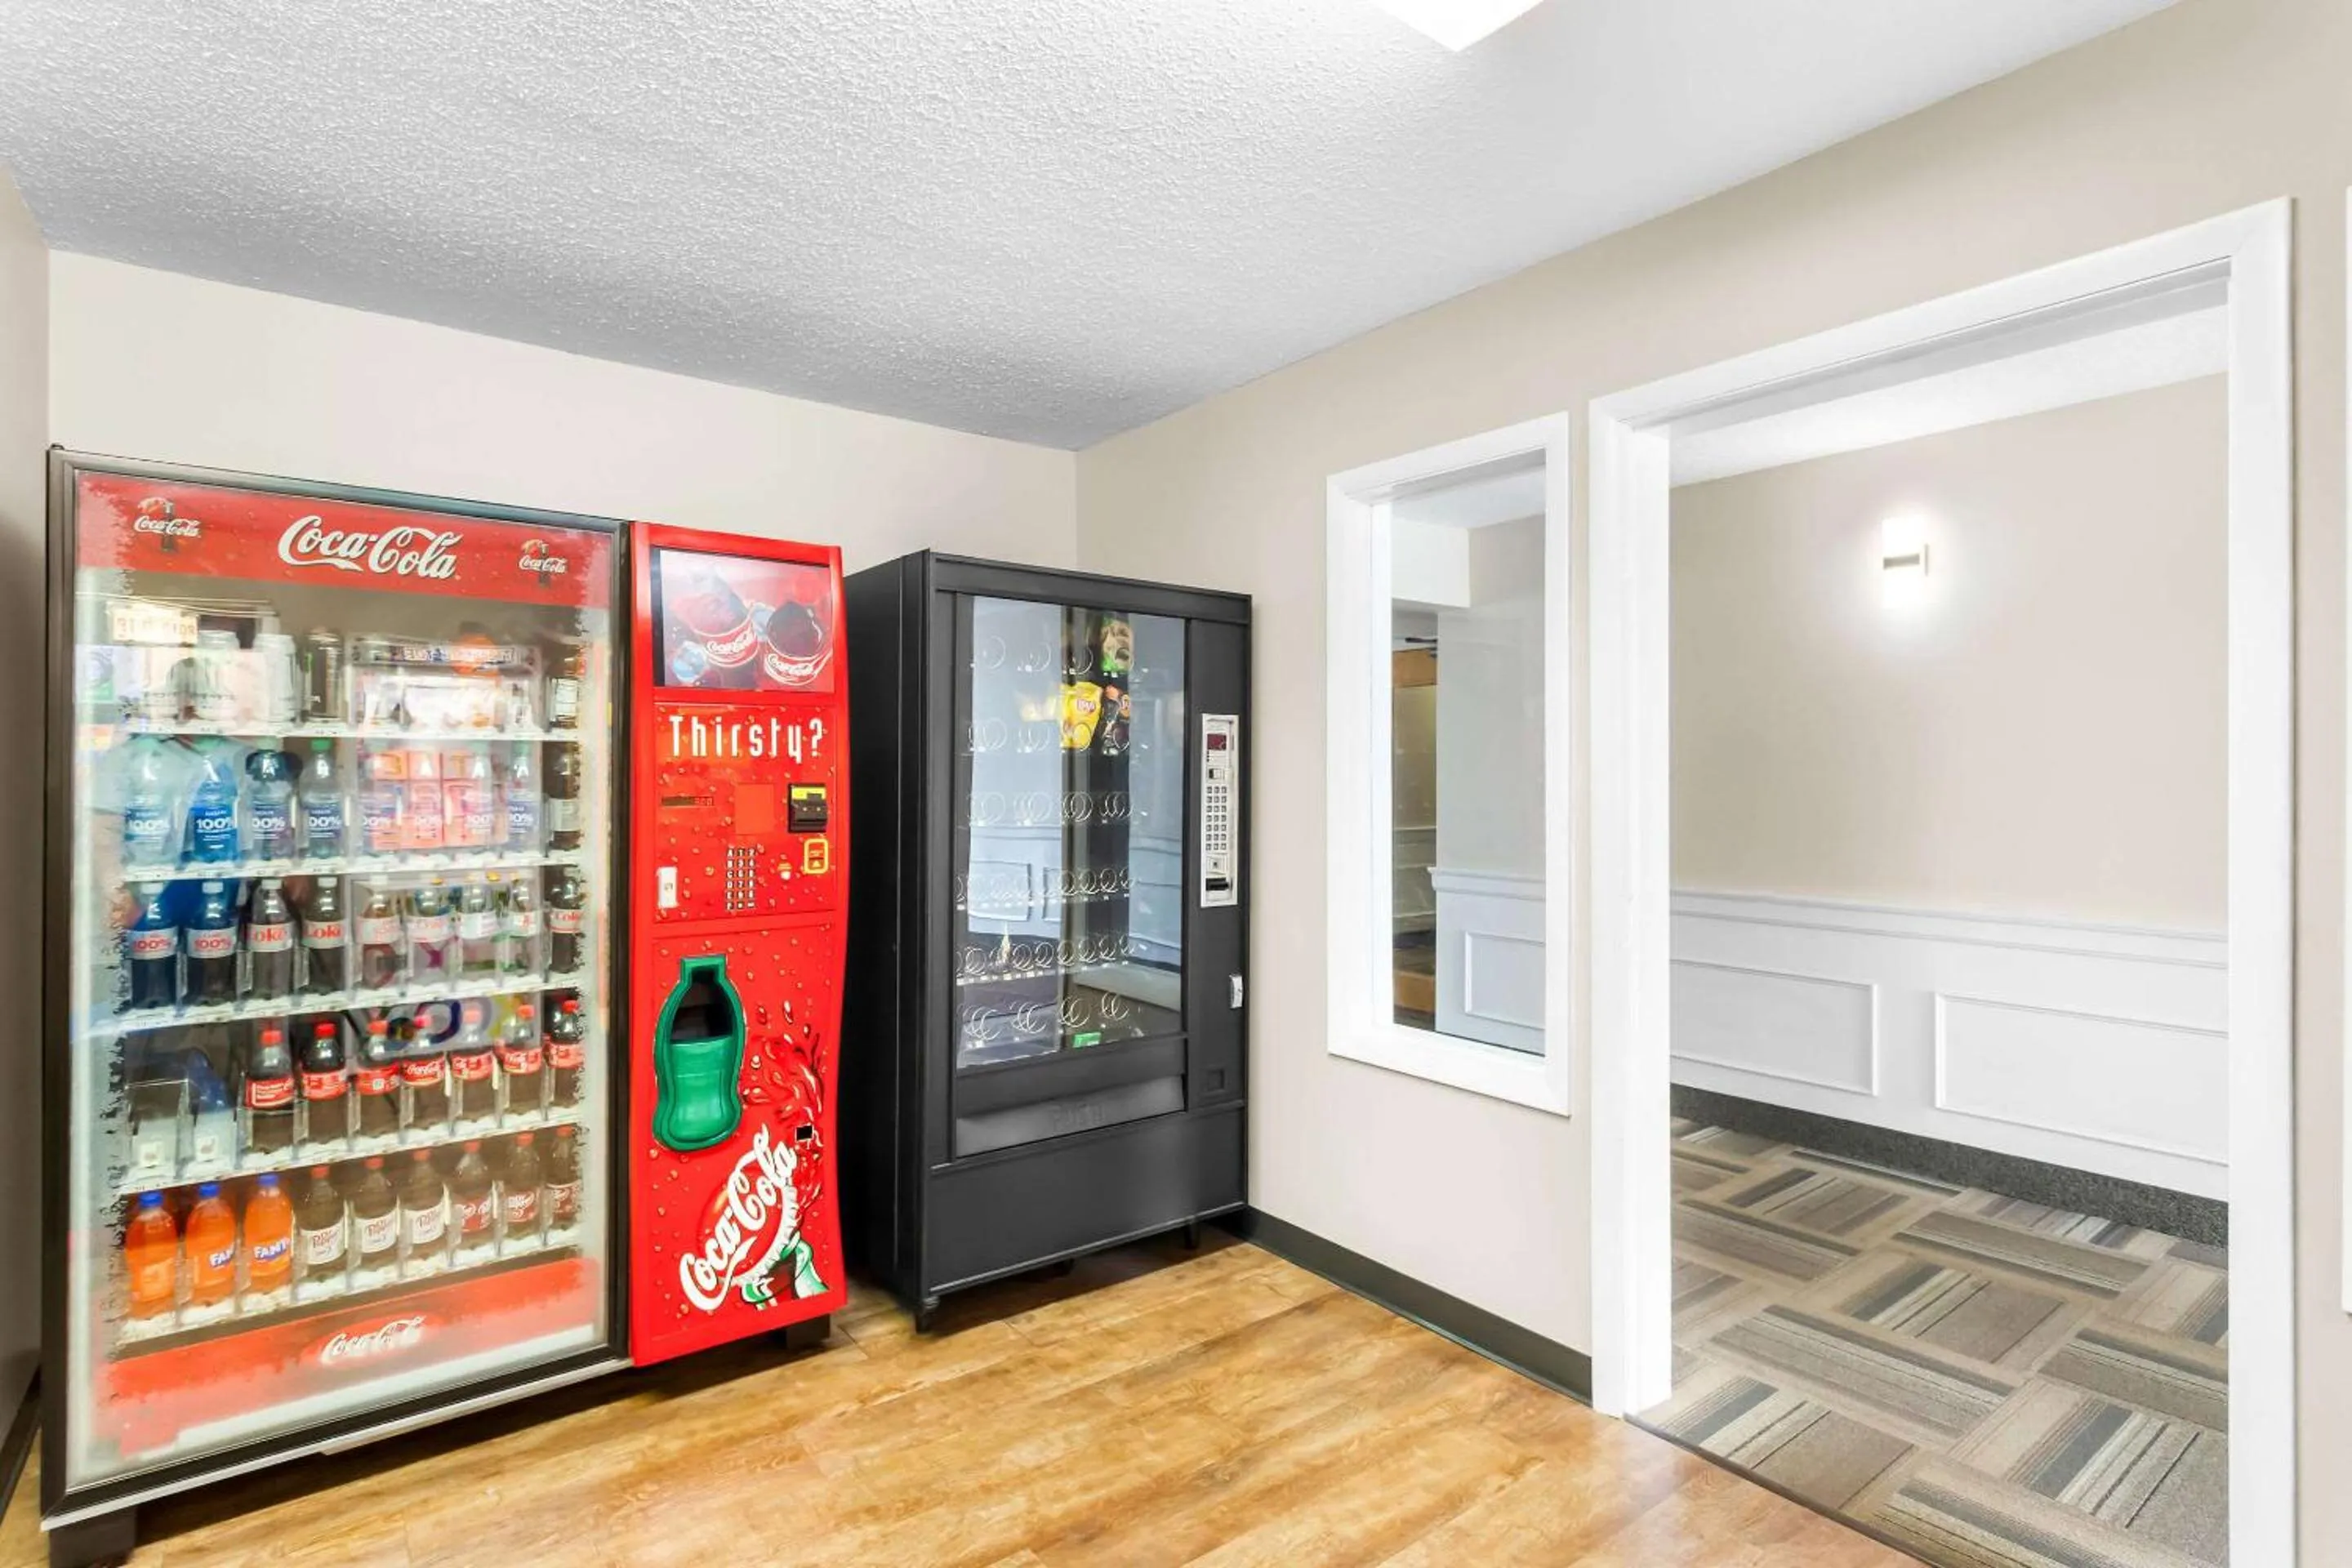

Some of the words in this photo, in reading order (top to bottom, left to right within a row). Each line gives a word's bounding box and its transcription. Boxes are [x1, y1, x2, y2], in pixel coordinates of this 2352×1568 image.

[134, 515, 201, 537] Coca-Cola
[278, 515, 464, 579] Coca-Cola
[519, 555, 568, 573] Coca-Cola
[669, 715, 823, 764] Thirsty?
[252, 817, 286, 829] 00%
[309, 817, 342, 828] 00%
[680, 1122, 798, 1312] Coca-Cola
[209, 1244, 235, 1267] FAN
